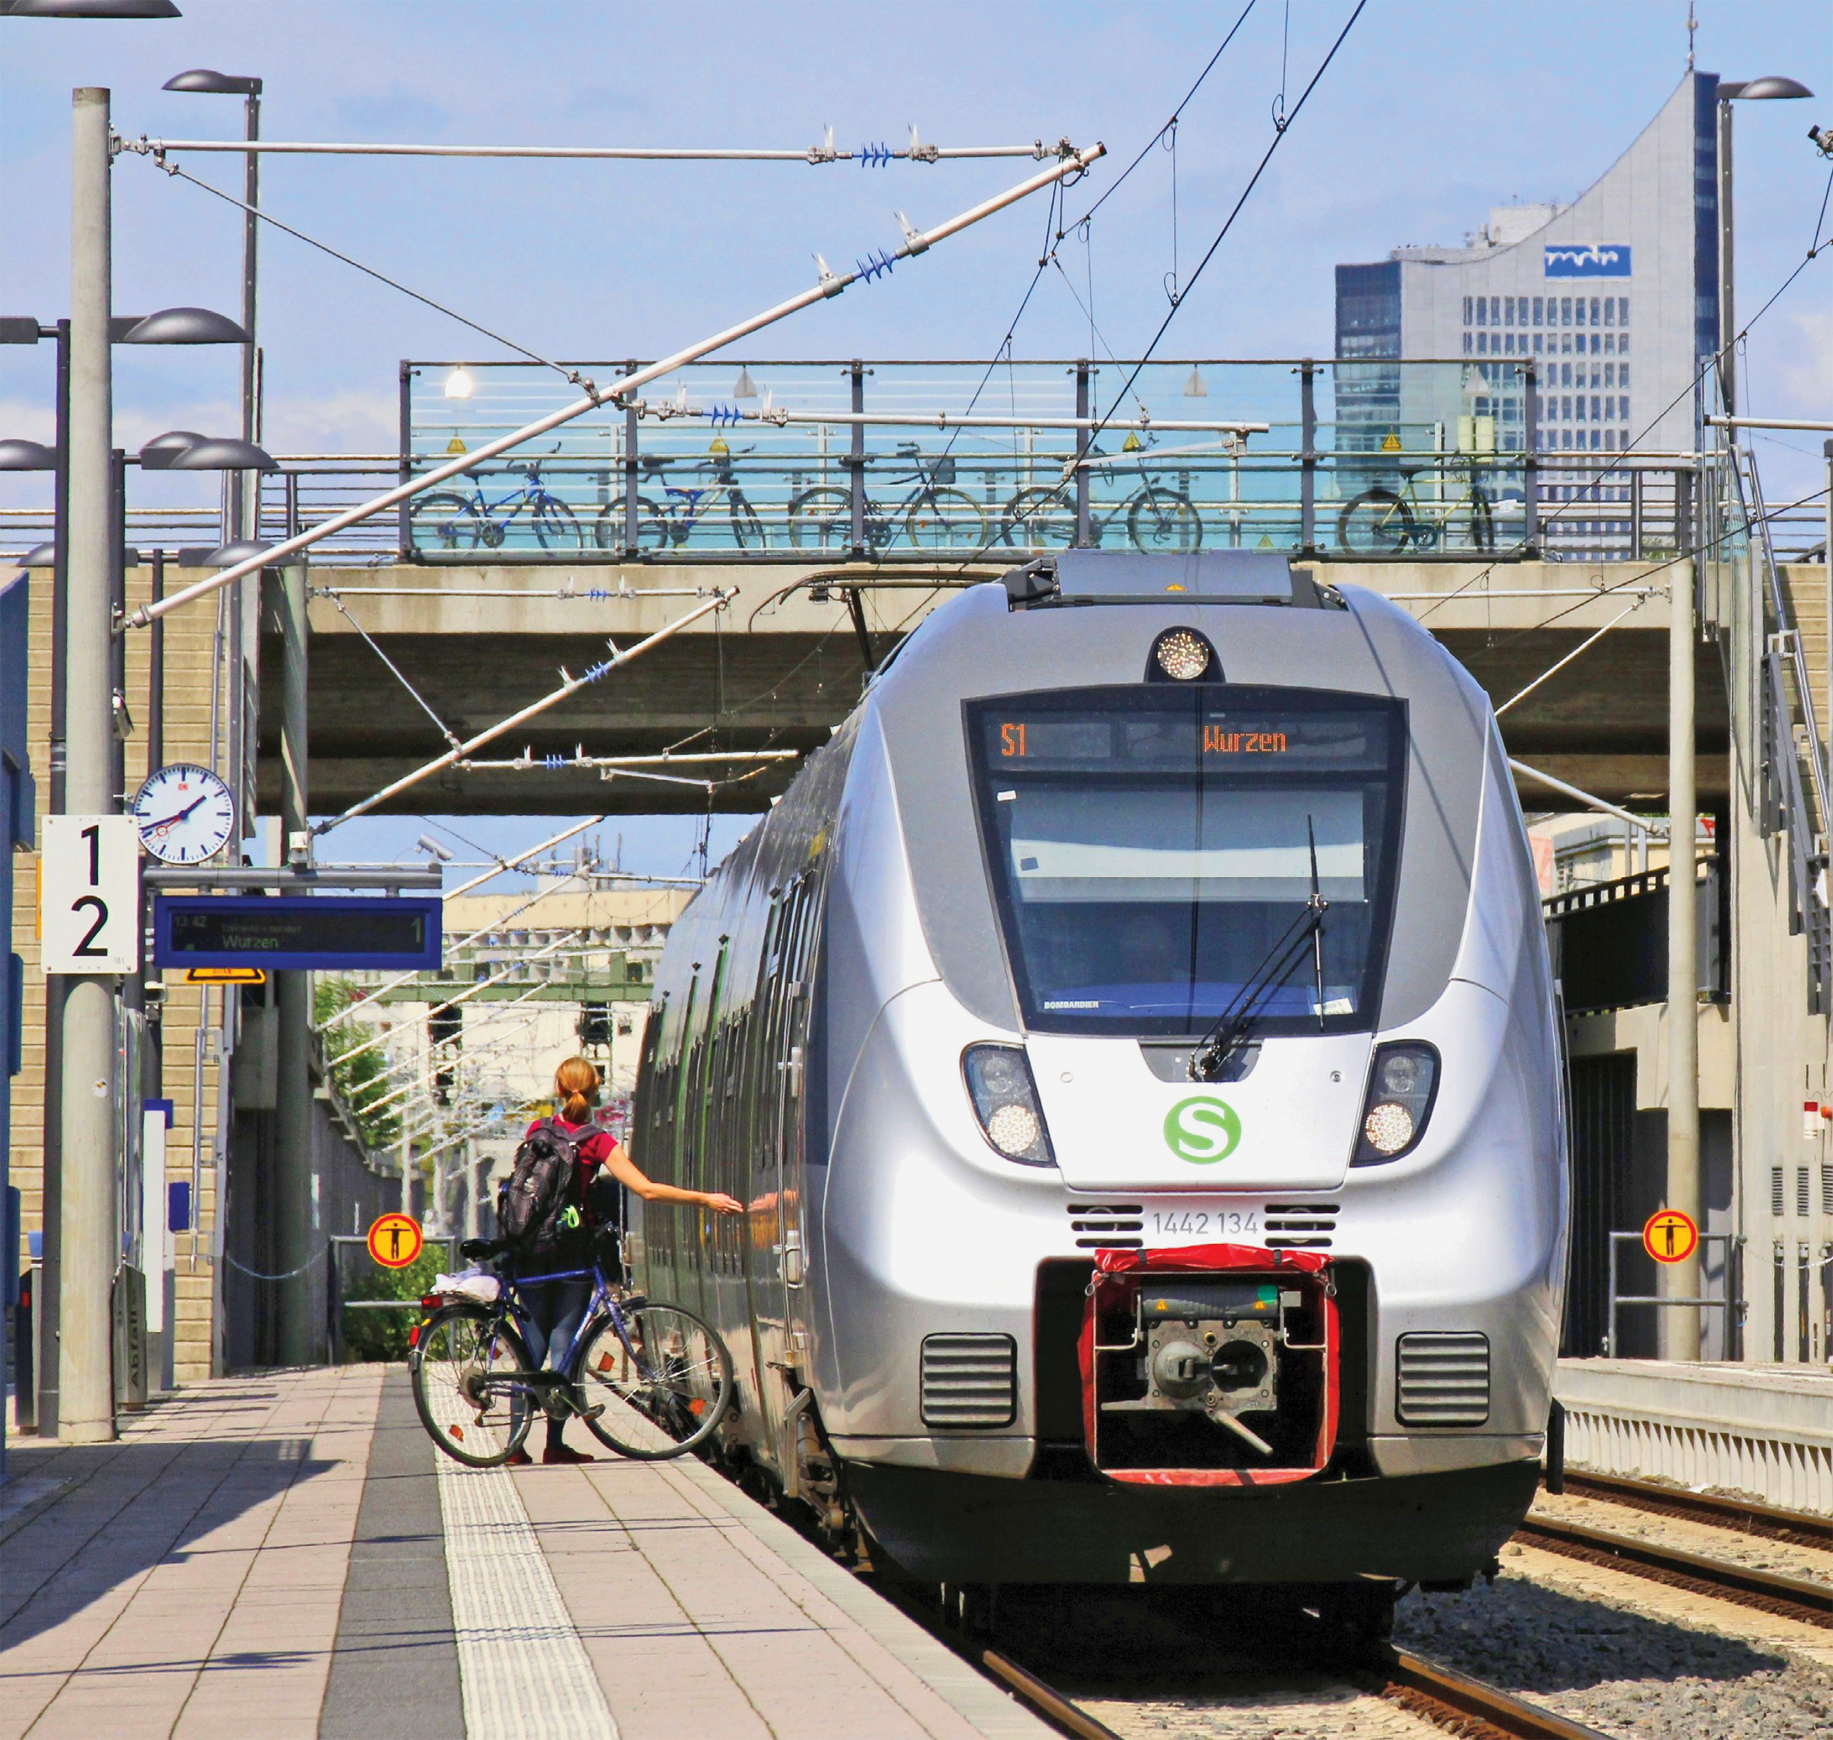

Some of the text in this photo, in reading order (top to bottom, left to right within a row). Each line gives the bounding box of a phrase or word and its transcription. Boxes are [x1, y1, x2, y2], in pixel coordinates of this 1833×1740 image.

[1001, 723, 1286, 756] S1 Wurzen
[81, 824, 99, 886] 1
[71, 895, 109, 957] 2
[222, 934, 279, 949] Wurzen
[411, 917, 421, 942] 1
[1044, 1001, 1099, 1009] BOMBARDIER
[1178, 1102, 1229, 1158] S
[1153, 1213, 1258, 1234] 1442 134
[130, 1309, 139, 1389] Abfall
